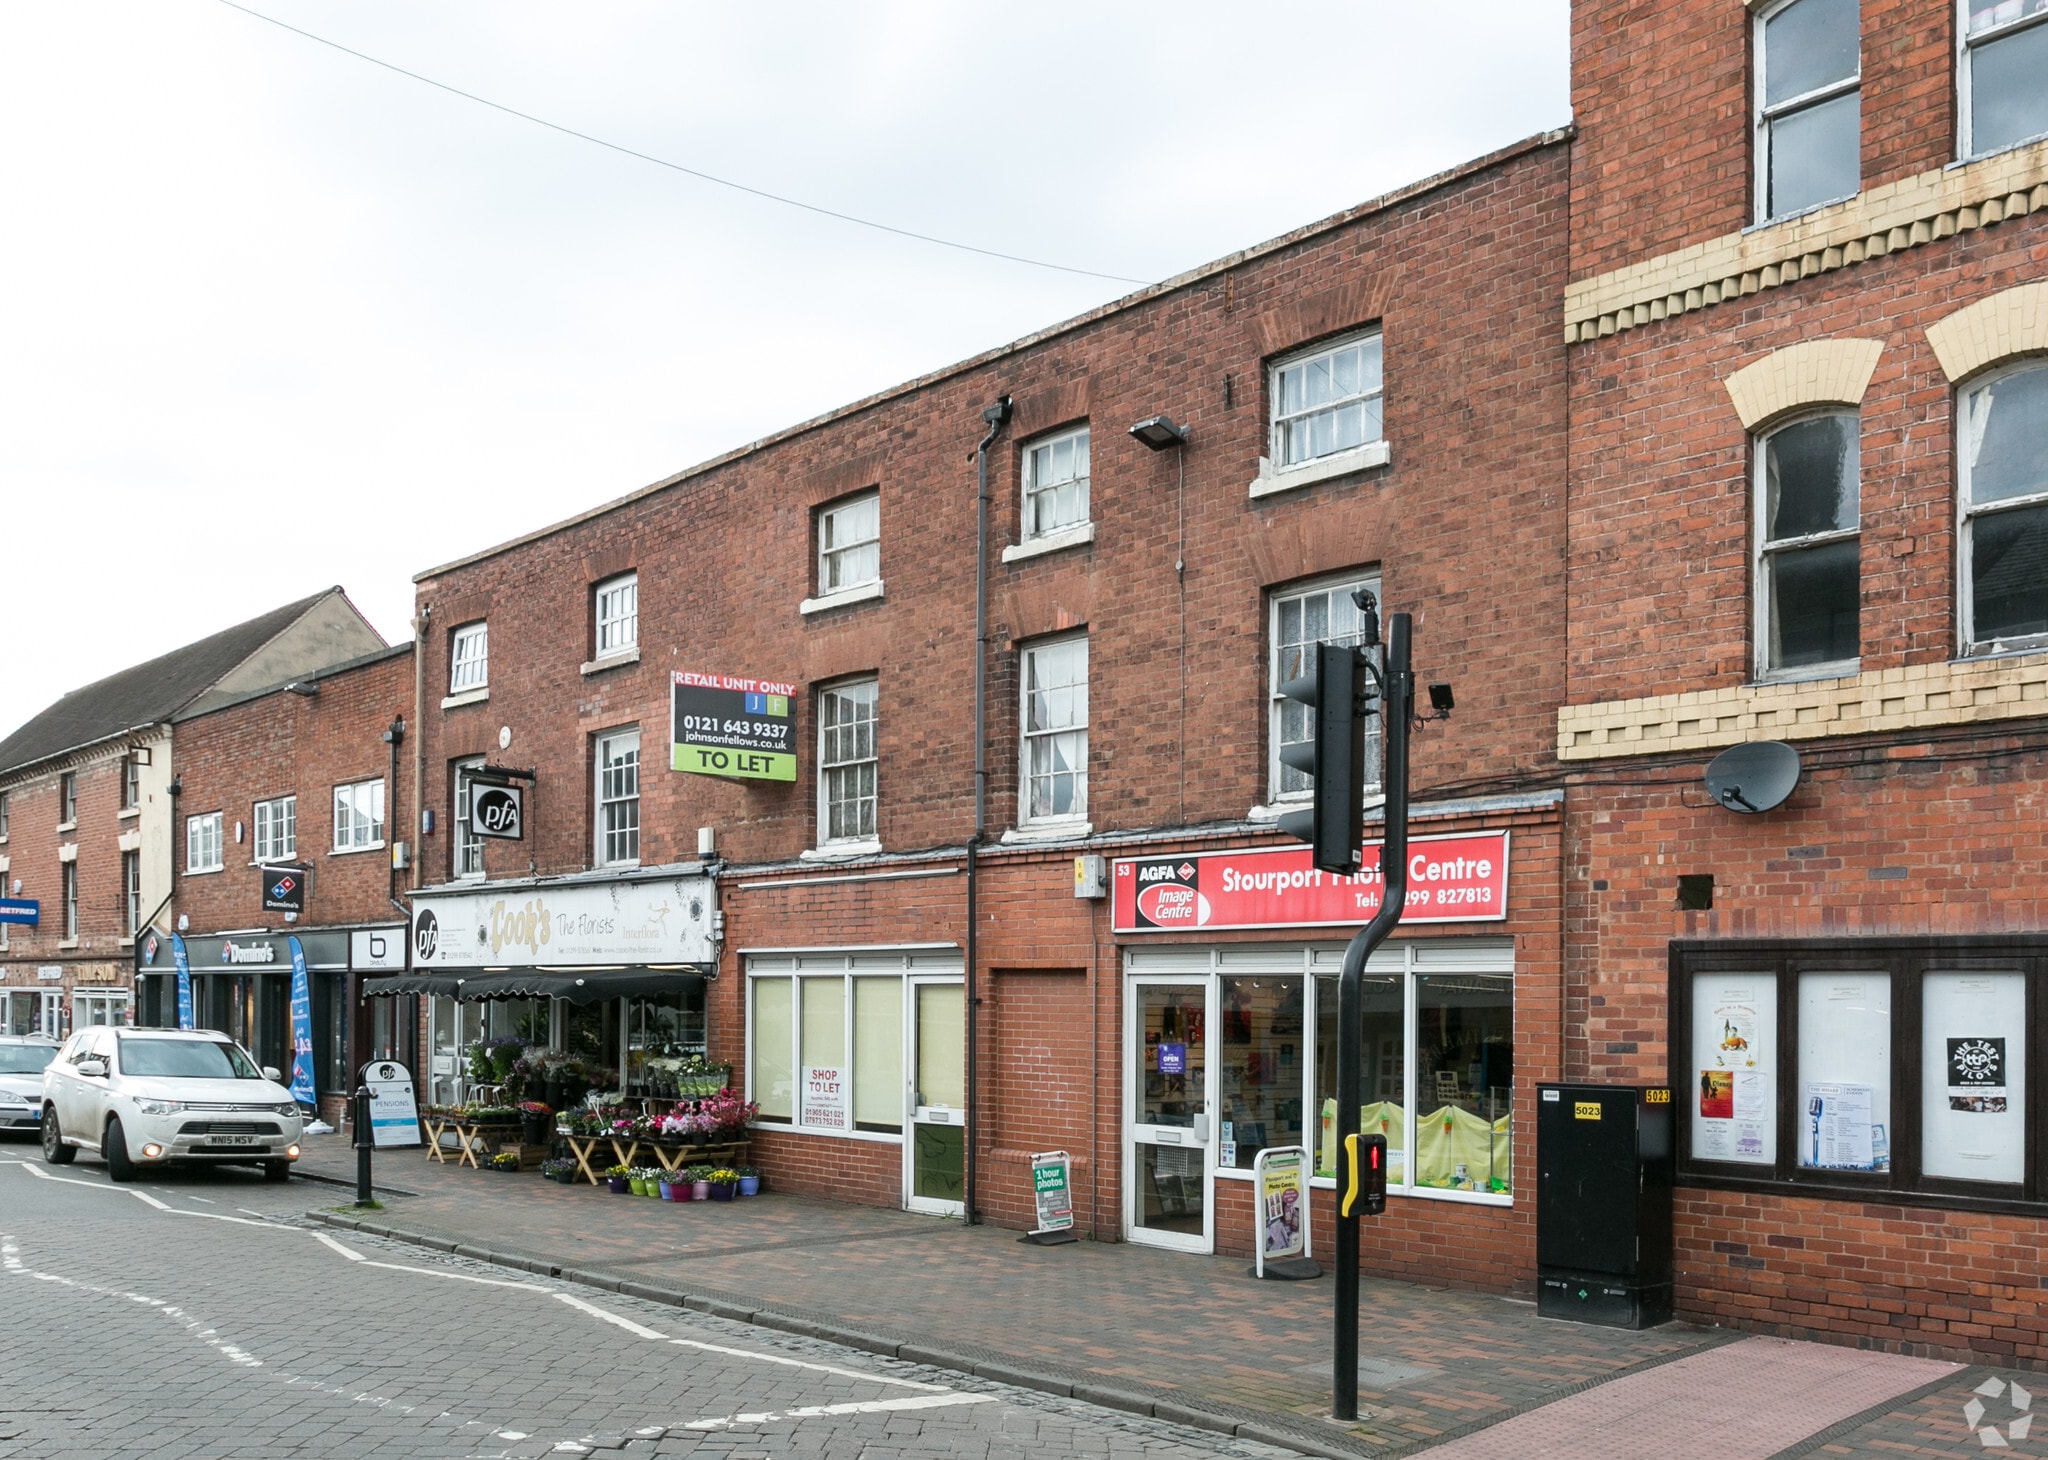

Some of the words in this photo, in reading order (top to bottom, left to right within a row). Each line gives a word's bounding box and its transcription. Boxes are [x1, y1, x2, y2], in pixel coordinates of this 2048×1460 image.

[675, 672, 720, 688] RETAIL
[723, 677, 756, 691] UNIT
[759, 681, 795, 696] ONLY
[752, 695, 759, 710] J
[773, 698, 781, 712] F
[683, 715, 719, 731] 0121
[723, 719, 750, 735] 643
[753, 722, 788, 738] 9337
[685, 730, 787, 750] johnsonfellows.co.uk
[697, 750, 729, 769] TO
[737, 754, 775, 773] LET
[1118, 864, 1130, 876] 53
[1139, 865, 1176, 881] AGFA
[1222, 867, 1322, 896] Stourport
[1409, 854, 1492, 882] Centre
[266, 900, 299, 909] Domino's
[1158, 889, 1194, 907] Image
[1355, 891, 1379, 907] Tel:
[1437, 886, 1492, 905] 827813
[1155, 904, 1193, 919] Centre
[491, 897, 551, 956] Cook's
[556, 913, 575, 937] The
[578, 913, 615, 937] Florists
[623, 925, 660, 941] Interflora
[231, 941, 274, 963] Domino's
[1954, 1042, 1971, 1060] THE
[1977, 1040, 1999, 1060] TEST
[812, 1069, 837, 1081] SHOP
[1956, 1064, 1998, 1080] PILOTS
[809, 1082, 821, 1092] TO
[823, 1083, 840, 1093] LET
[1647, 1090, 1669, 1101] 5023
[805, 1108, 822, 1117] 01905
[823, 1110, 833, 1118] 621
[1575, 1106, 1600, 1116] 5023
[823, 1118, 832, 1126] 752
[1036, 1170, 1041, 1180] 1
[1042, 1168, 1060, 1178] hour
[1037, 1178, 1063, 1190] photos
